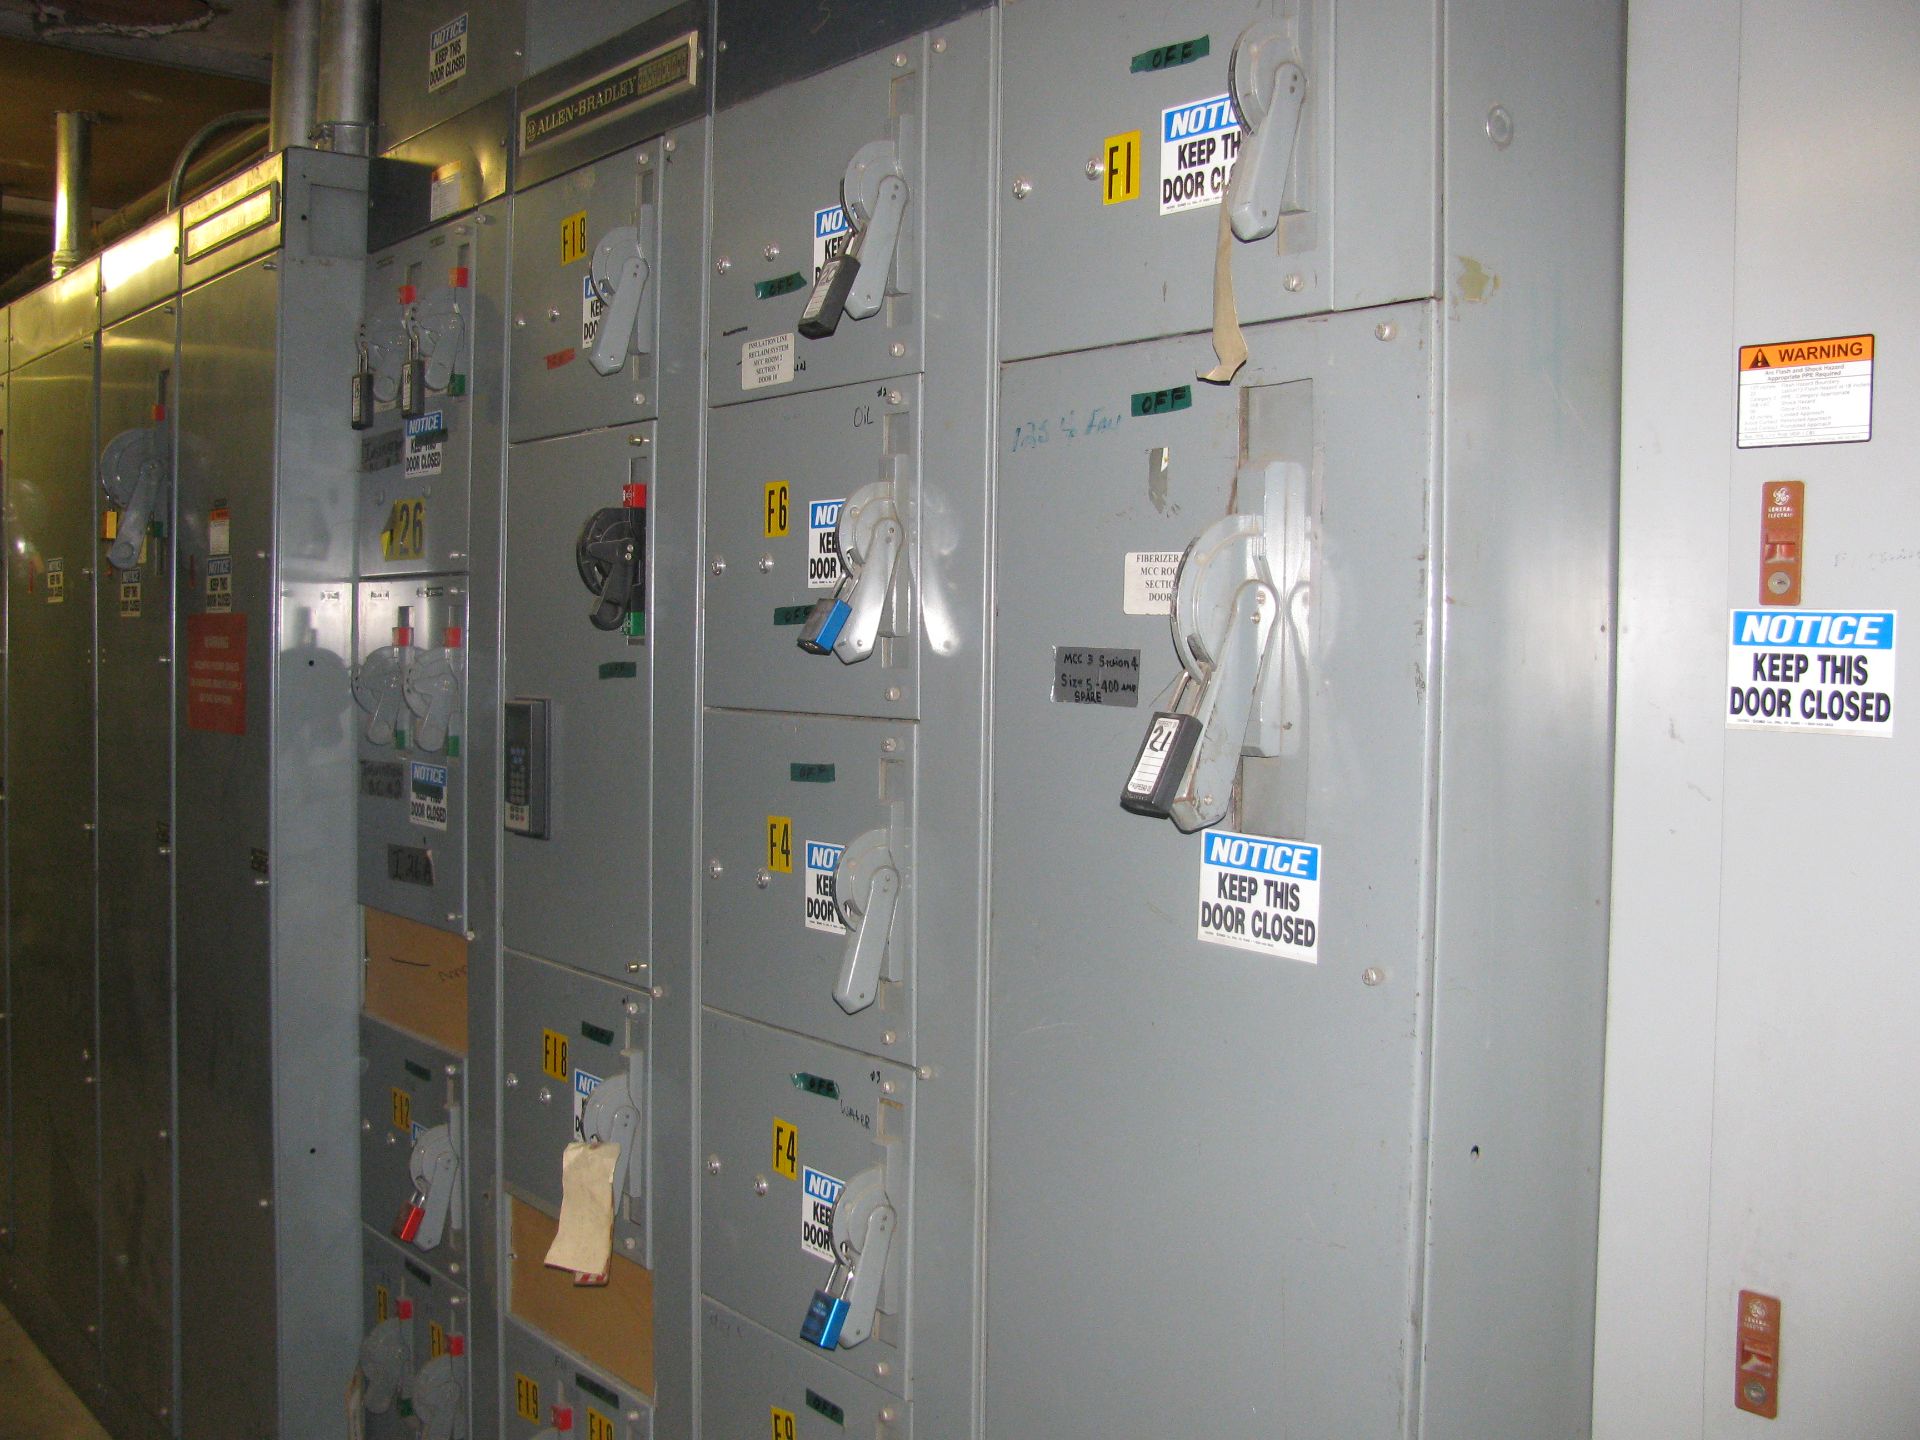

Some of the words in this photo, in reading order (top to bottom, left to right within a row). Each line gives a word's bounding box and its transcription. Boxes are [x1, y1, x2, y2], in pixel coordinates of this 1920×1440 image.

[432, 18, 465, 49] NOTICE
[435, 45, 449, 66] KEEP
[1152, 42, 1194, 68] OFF
[537, 77, 637, 136] ALLEN-BRADLEY
[1170, 99, 1238, 139] NOTI
[1178, 137, 1217, 171] KEEP
[1162, 170, 1205, 205] DOOR
[562, 217, 586, 262] F18
[1778, 342, 1863, 363] WARNING
[1141, 387, 1186, 415] OFF
[408, 414, 439, 435] NOTICE
[405, 456, 421, 472] DOOR
[421, 451, 441, 468] CLOSED
[767, 486, 788, 533] F6
[819, 532, 837, 554] KEE
[809, 557, 837, 580] DOOR
[1136, 554, 1179, 563] FIBERIZER
[1140, 566, 1159, 576] MCC
[1161, 566, 1177, 576] ROO
[1145, 579, 1175, 589] SECTIO
[1148, 592, 1172, 601] DOOR
[1741, 614, 1885, 646] NOTICE
[1063, 653, 1083, 665] MCC
[1752, 652, 1809, 683] KEEP
[1817, 654, 1869, 686] THIS
[1074, 690, 1103, 703] SPARE
[1730, 686, 1791, 718] DOOR
[1800, 688, 1891, 723] CLOSED
[1149, 725, 1172, 752] 21
[413, 766, 445, 784] NOTICE
[411, 801, 425, 817] DOOR
[426, 804, 447, 823] CLOSED
[770, 823, 791, 867] F4
[1210, 836, 1312, 876] NOTICE
[816, 873, 834, 897] KEE
[1217, 871, 1258, 904] KEEP
[1263, 878, 1300, 912] THIS
[807, 896, 834, 923] DOOR
[1201, 900, 1245, 935] DOOR
[1251, 909, 1316, 948] CLOSED
[544, 1034, 567, 1077] F18
[775, 1125, 796, 1173] F4
[813, 1201, 832, 1227] KEE
[803, 1221, 830, 1251] DOOR
[517, 1378, 538, 1419] F19
